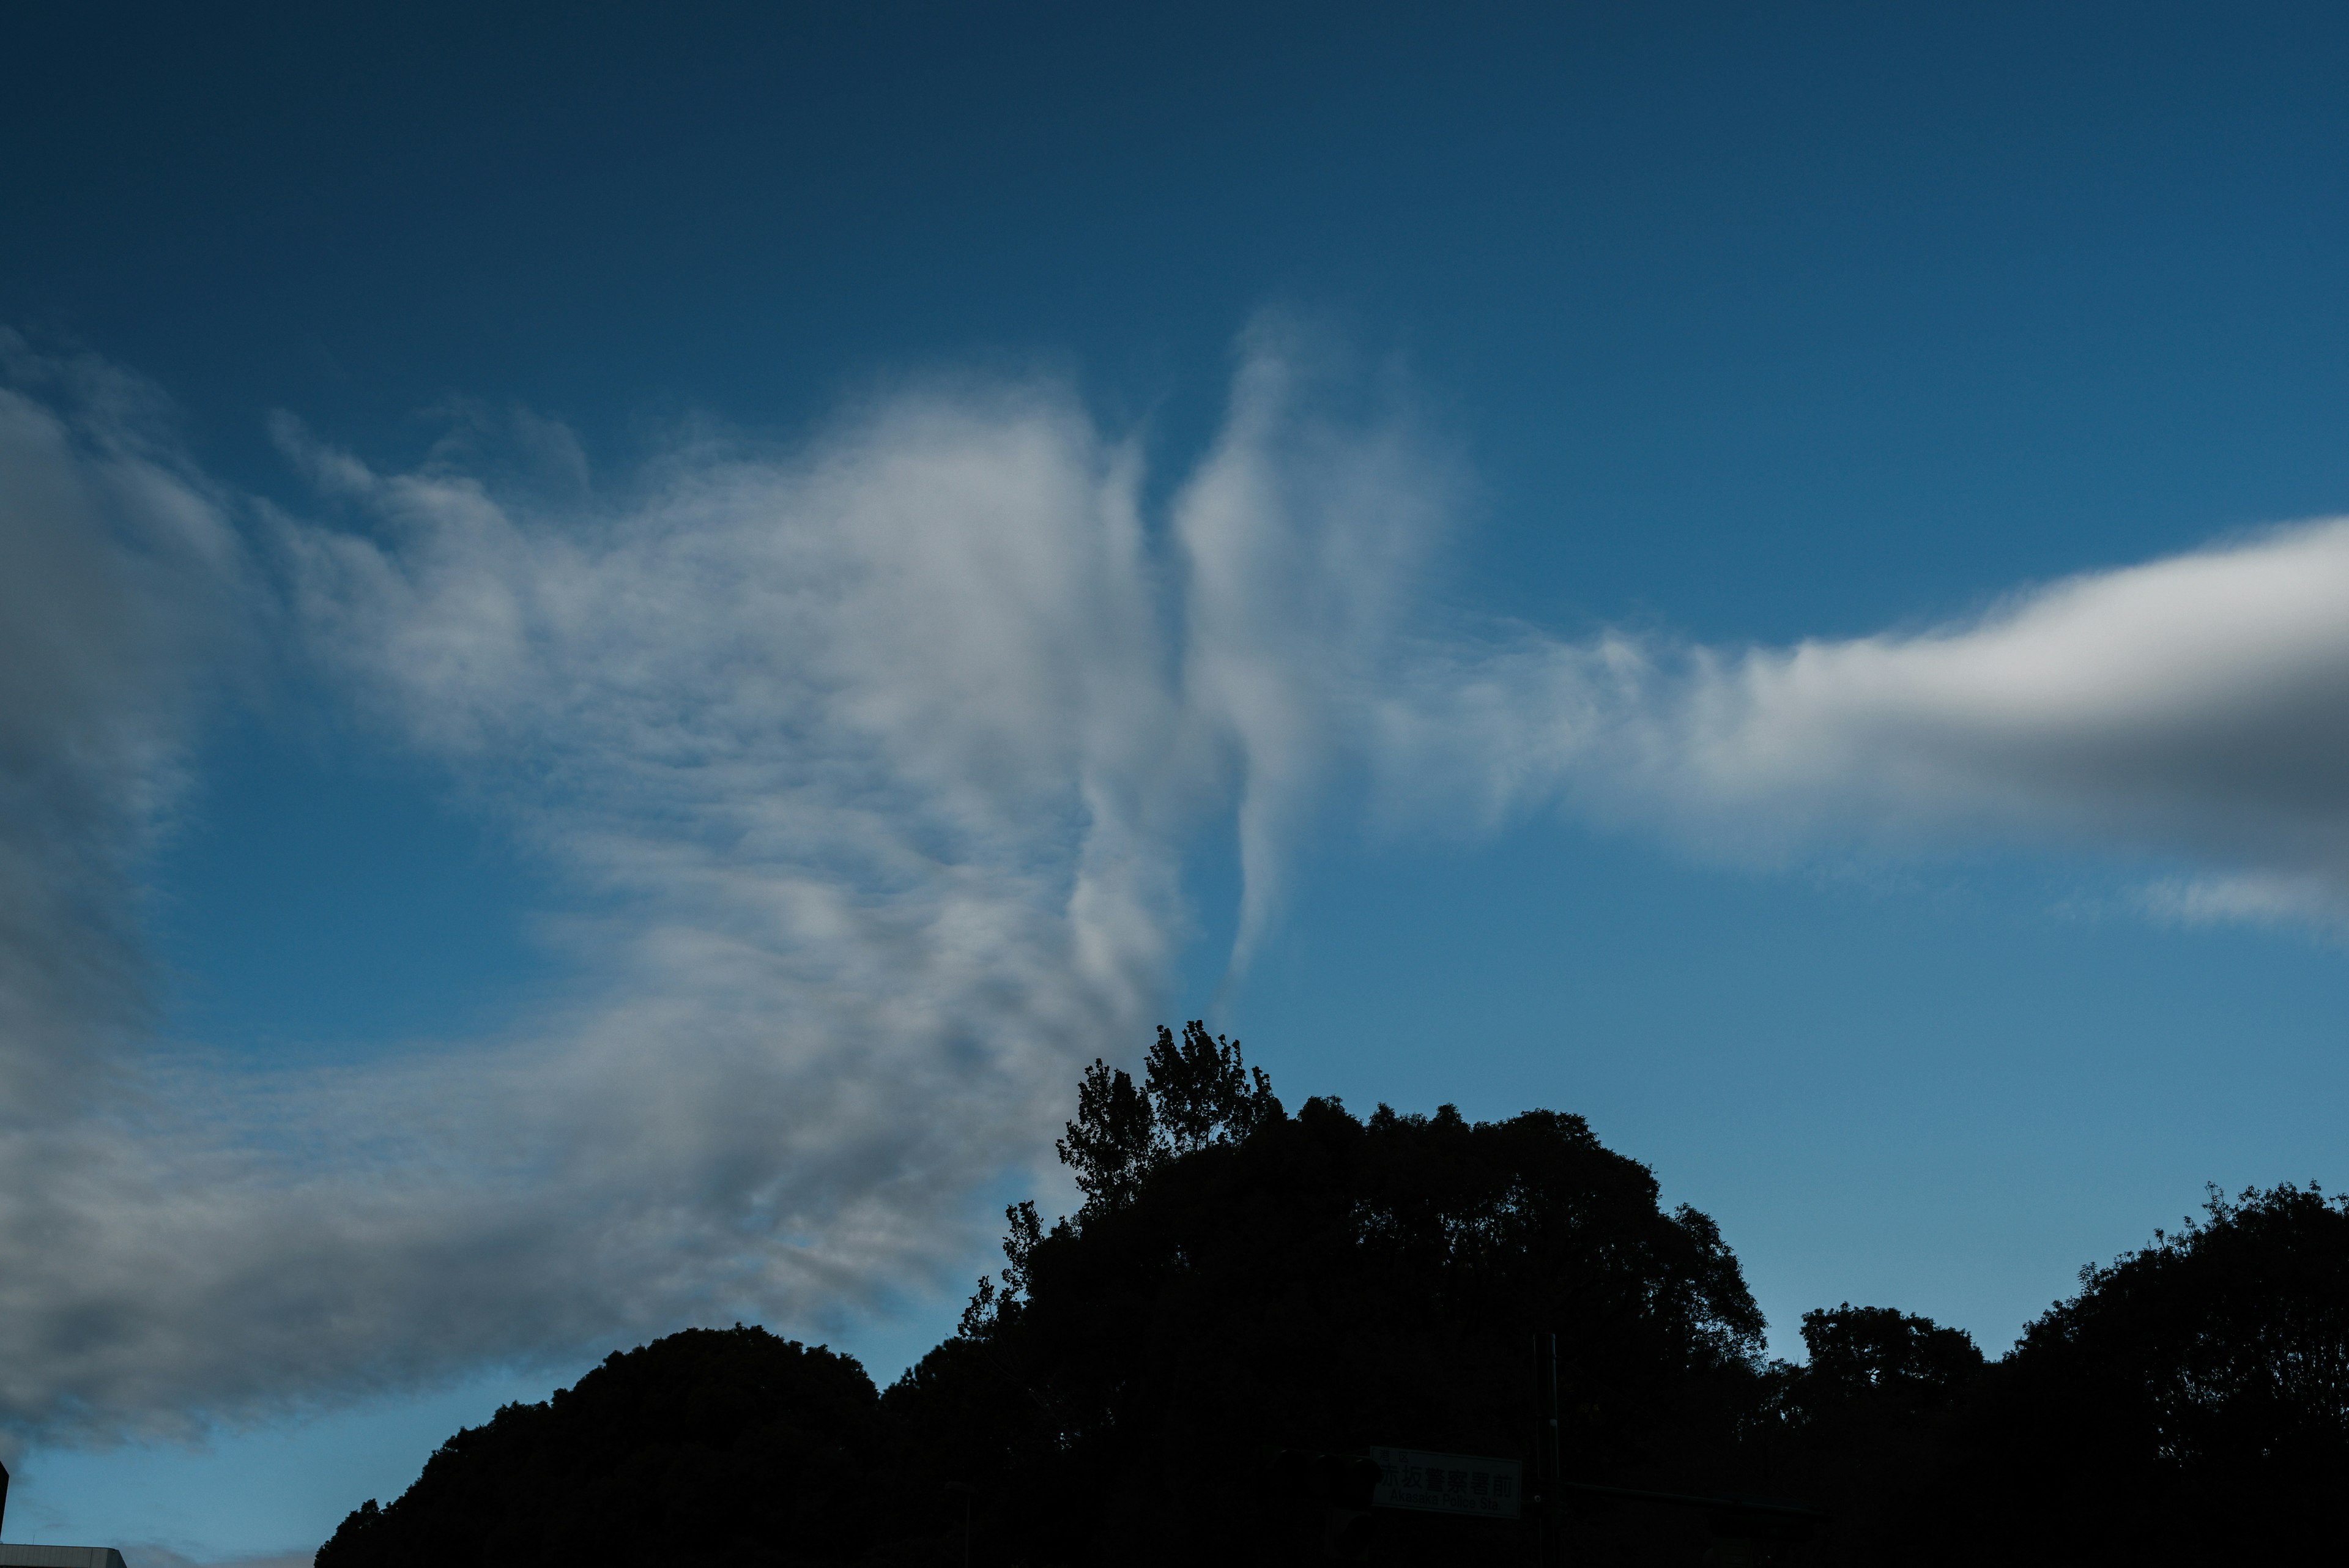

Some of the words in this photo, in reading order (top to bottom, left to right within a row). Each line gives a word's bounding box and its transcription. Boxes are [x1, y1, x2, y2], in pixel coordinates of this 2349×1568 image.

[1379, 1463, 1513, 1498] 赤坂警察署前
[1390, 1489, 1438, 1504] Akasaka
[1443, 1494, 1475, 1509] Police
[1480, 1498, 1502, 1510] Sta.
